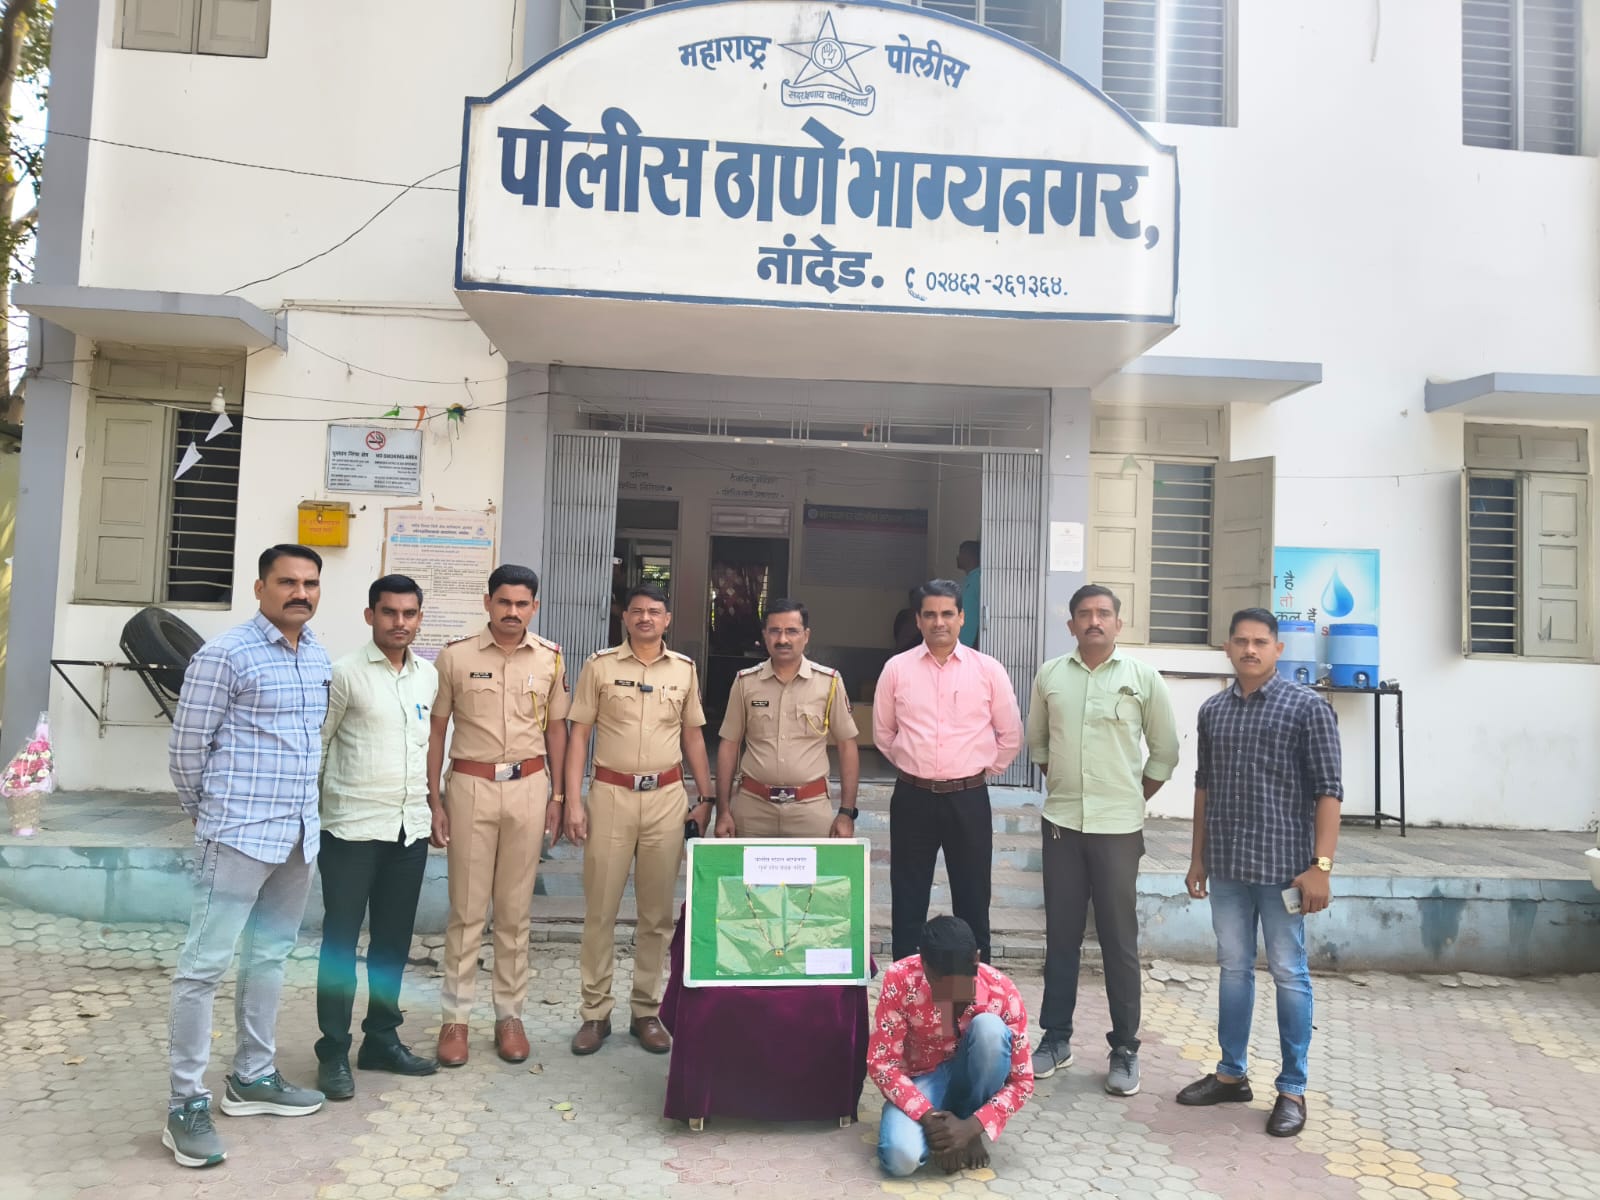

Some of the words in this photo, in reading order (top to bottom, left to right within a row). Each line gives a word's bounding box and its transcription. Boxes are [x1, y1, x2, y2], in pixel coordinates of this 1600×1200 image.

[678, 35, 773, 70] महाराष्ट्र
[885, 33, 971, 88] पोलीस
[497, 104, 709, 218] पोलीस
[714, 116, 846, 223] ठाणे
[847, 146, 1160, 250] भाग्यनगर,
[756, 233, 884, 294] नांदेड.
[1280, 592, 1295, 608] तो
[1284, 570, 1295, 590] है
